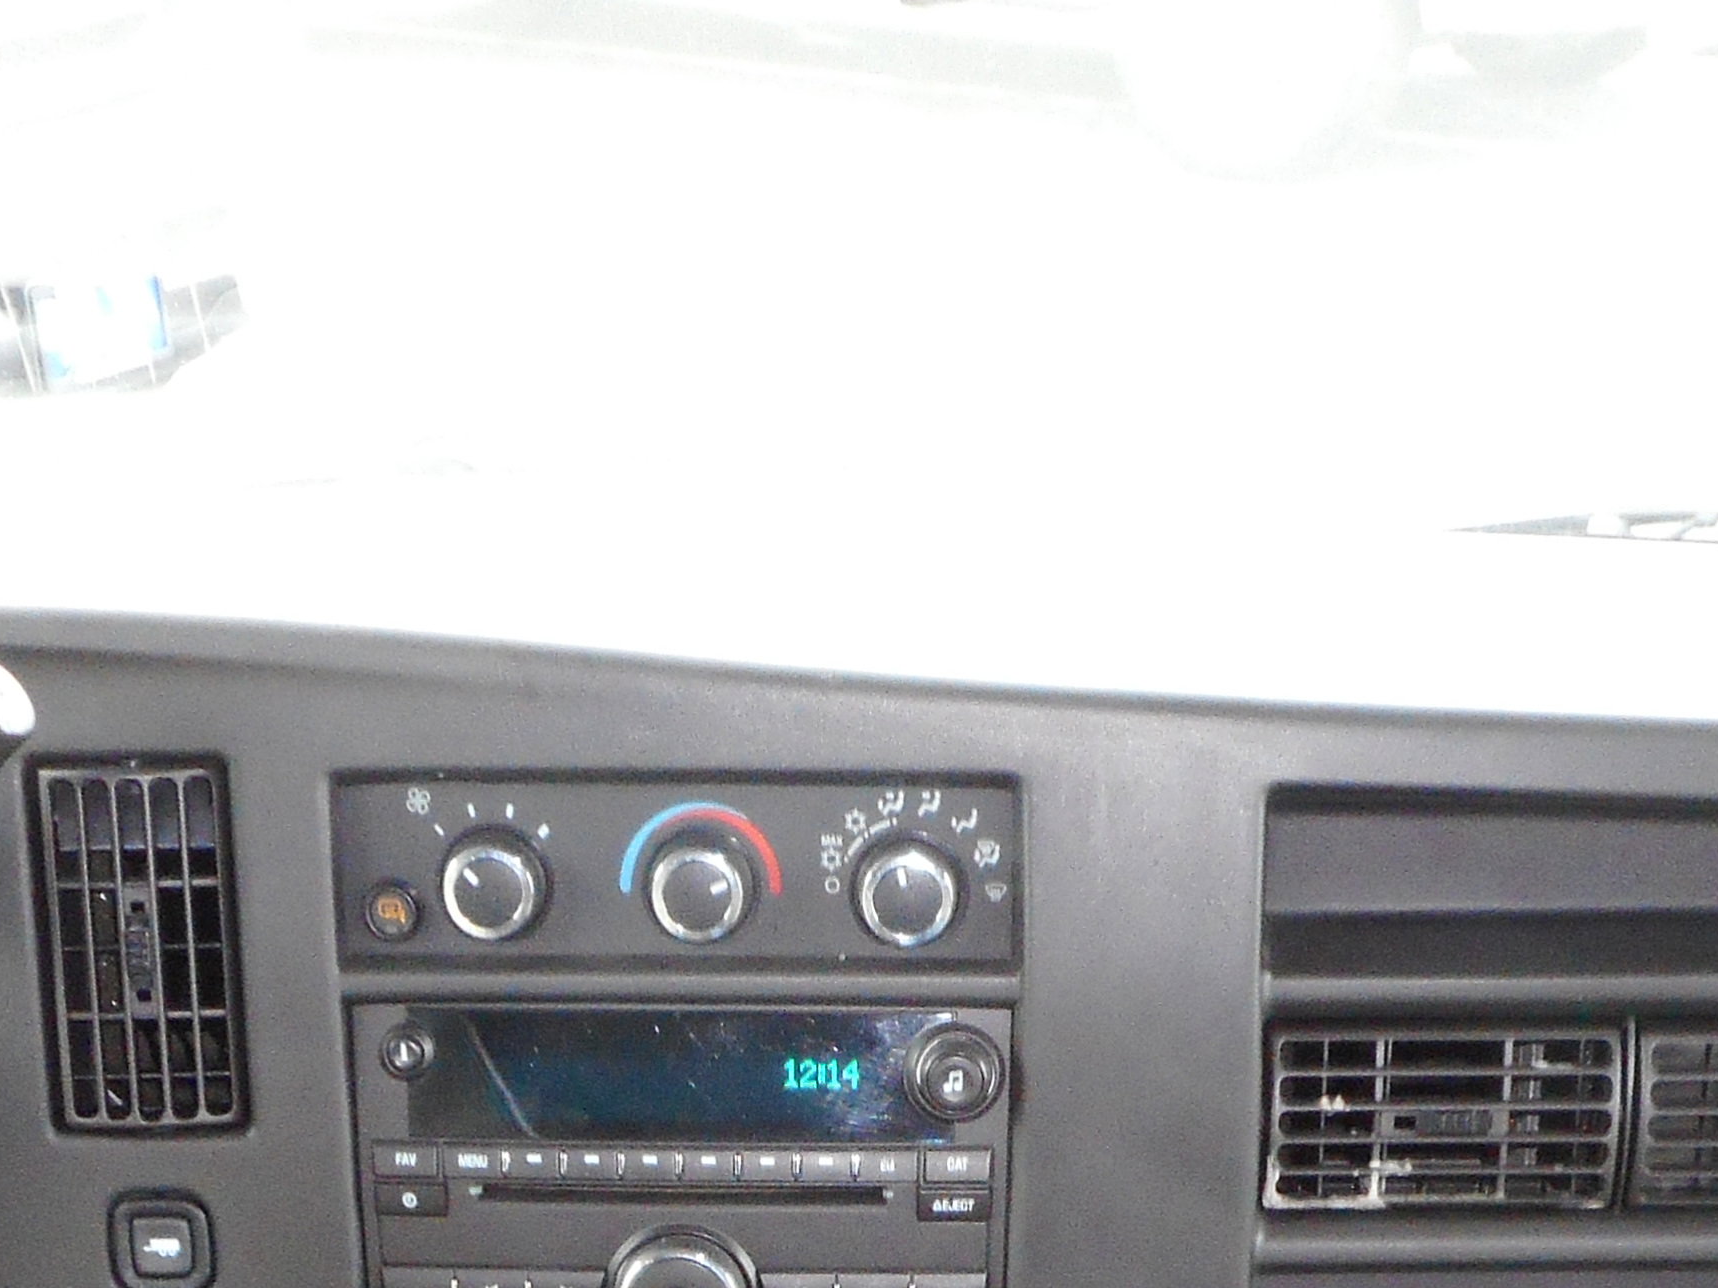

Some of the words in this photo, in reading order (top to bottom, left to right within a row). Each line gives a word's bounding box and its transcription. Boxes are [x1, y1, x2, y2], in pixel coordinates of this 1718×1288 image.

[784, 1058, 860, 1090] 12:14
[395, 1152, 417, 1167] FAV
[458, 1153, 488, 1168] MENU
